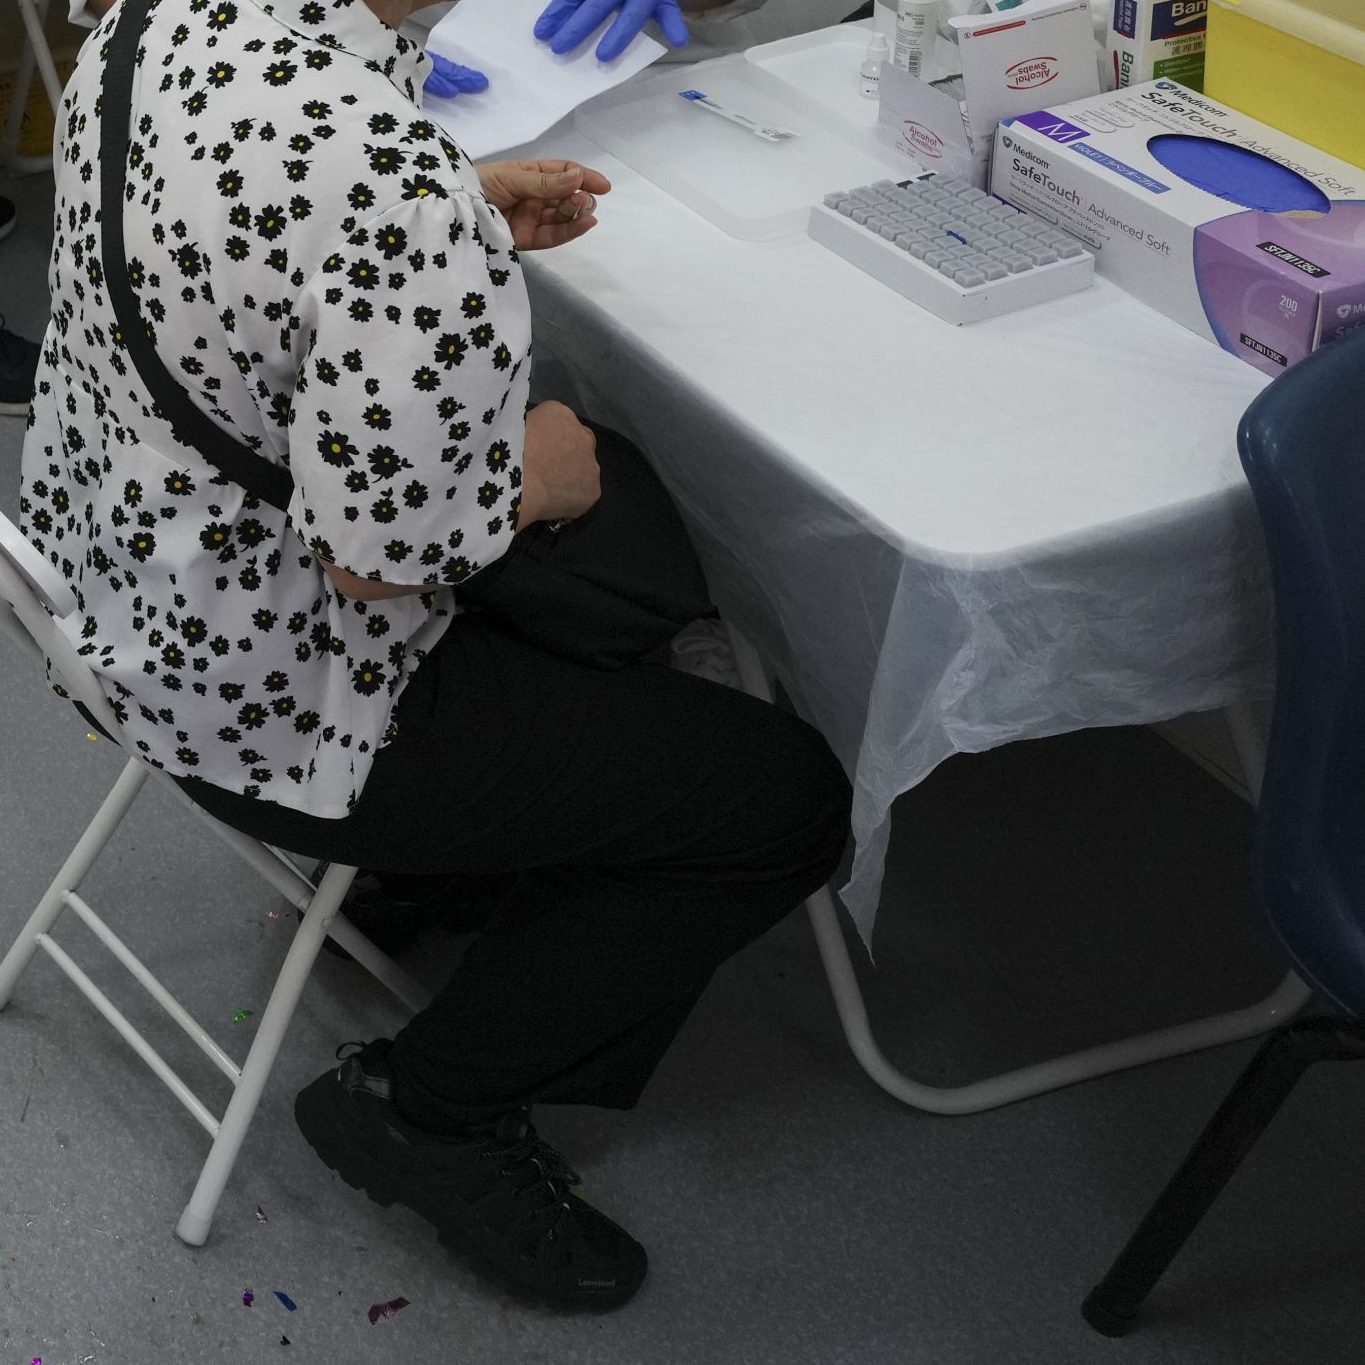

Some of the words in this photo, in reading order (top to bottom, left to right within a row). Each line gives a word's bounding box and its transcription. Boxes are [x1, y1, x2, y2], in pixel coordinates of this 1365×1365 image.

[1015, 69, 1050, 85] Alcohol
[1017, 62, 1047, 75] Swabs
[1170, 90, 1226, 118] Medicom
[909, 125, 937, 147] Alcohol
[1037, 122, 1080, 142] M
[1141, 92, 1237, 137] SafeTouch
[1239, 140, 1318, 178] Advanced
[1318, 176, 1356, 195] Soft
[1012, 143, 1049, 169] Medicom
[1074, 142, 1102, 160] VIOLET
[1012, 158, 1080, 206] SafeTouch
[1088, 203, 1144, 241] Advanced
[1146, 235, 1171, 256] Soft
[1264, 244, 1321, 274] SFTJN1135C
[1279, 294, 1298, 312] 200
[1244, 336, 1282, 363] SFTJN1135C
